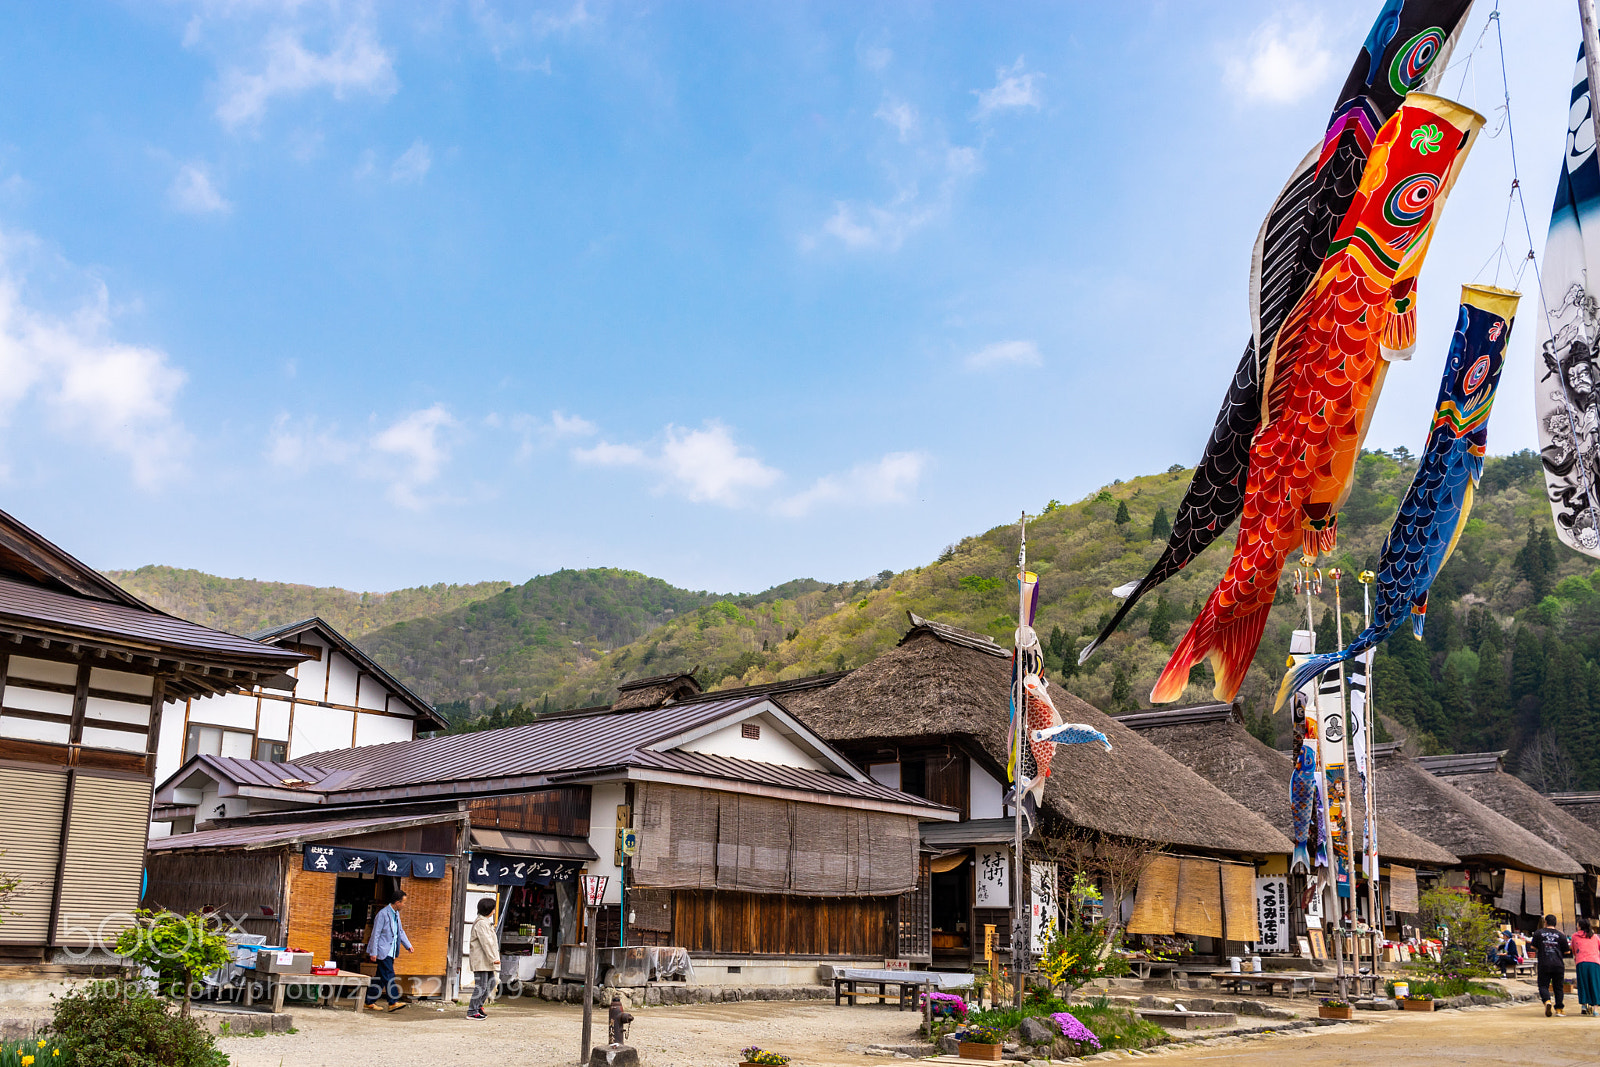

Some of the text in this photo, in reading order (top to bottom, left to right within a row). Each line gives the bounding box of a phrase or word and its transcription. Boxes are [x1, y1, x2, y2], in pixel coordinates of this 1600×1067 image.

[314, 854, 434, 875] 会津ぬり
[992, 851, 1006, 887] 手打ち
[1262, 882, 1278, 945] くるみそば
[1013, 923, 1024, 970] 大内宿
